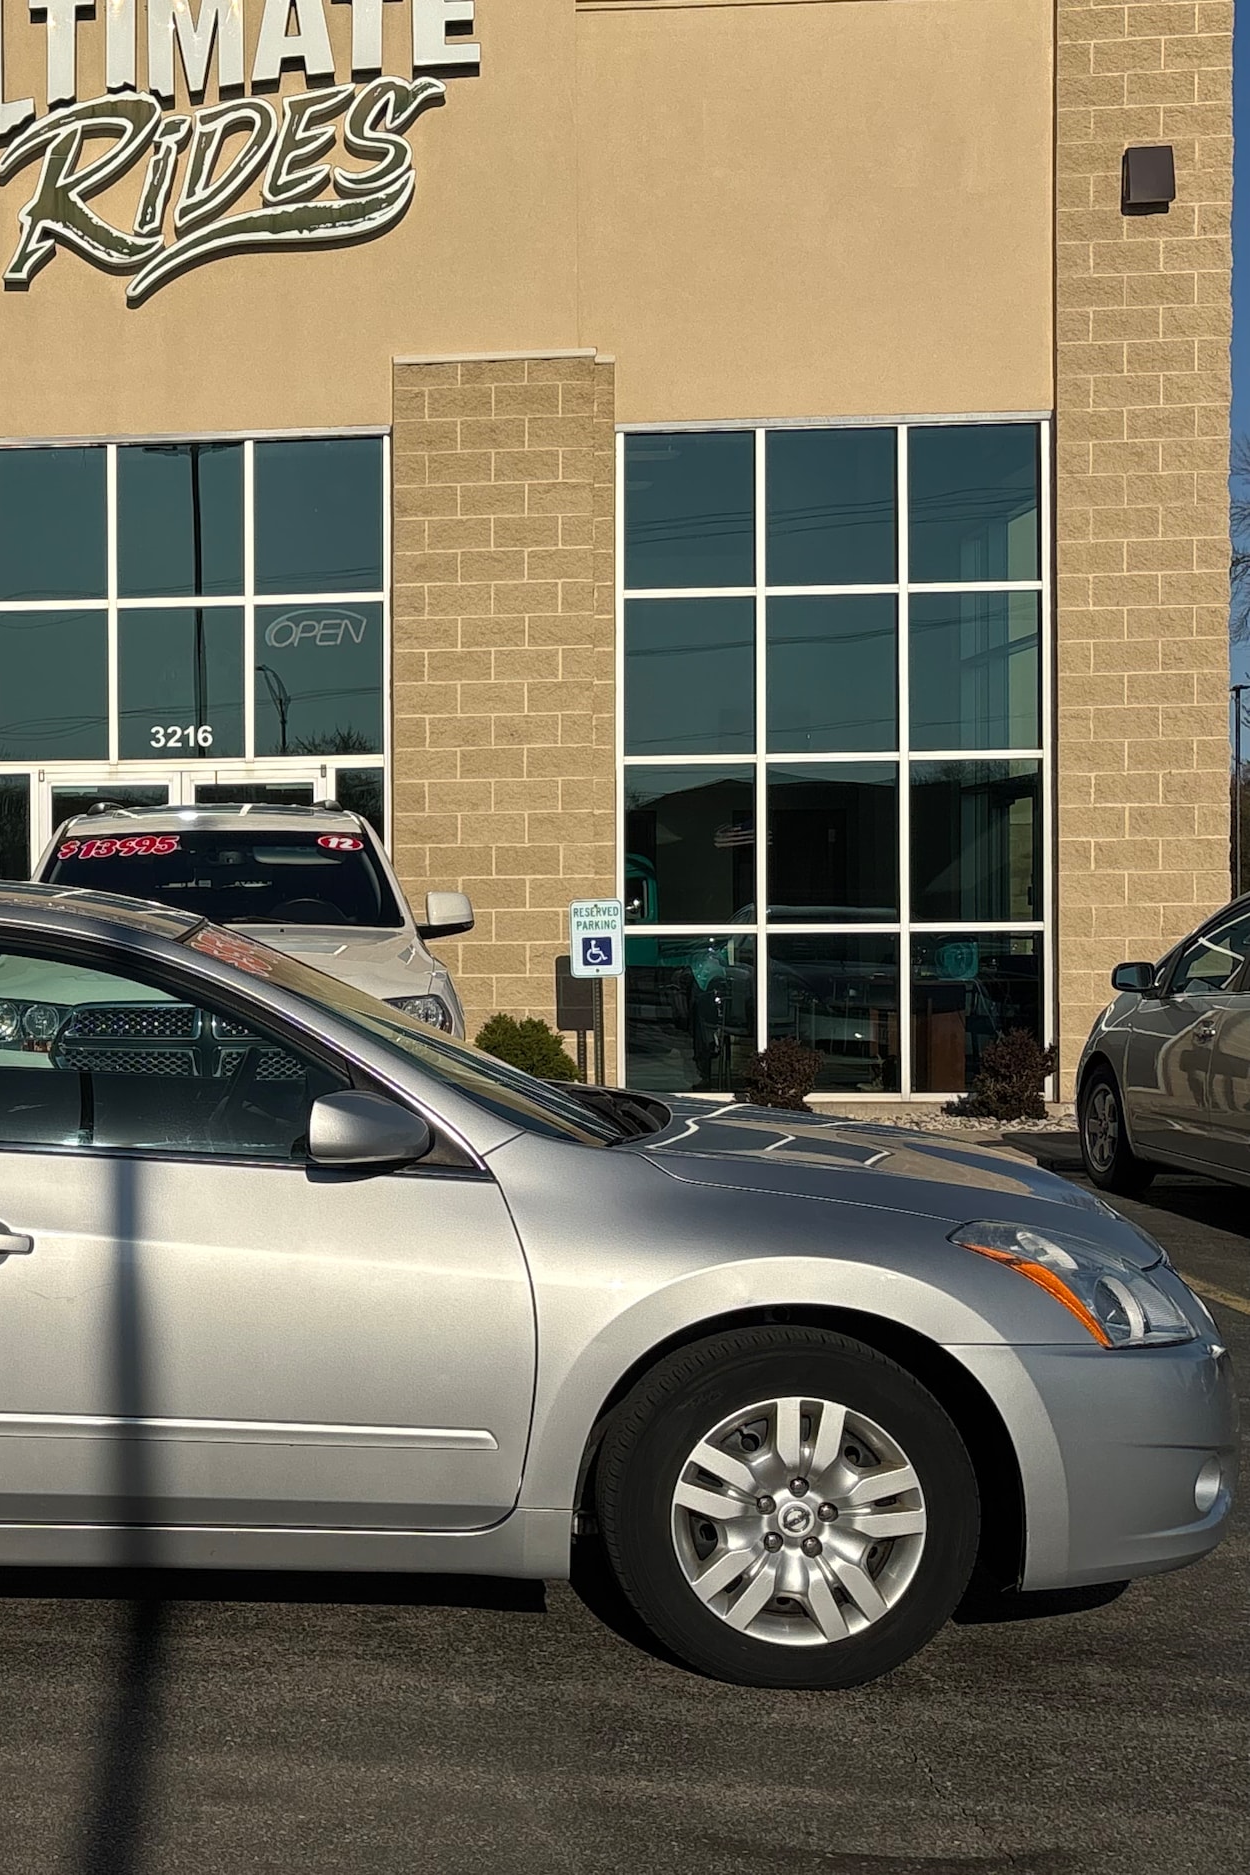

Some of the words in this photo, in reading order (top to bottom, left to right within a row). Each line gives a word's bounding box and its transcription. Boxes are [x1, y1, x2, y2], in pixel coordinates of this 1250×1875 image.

[270, 618, 368, 648] OPEN
[149, 724, 214, 748] 3216
[572, 905, 620, 918] RESERVED
[575, 919, 618, 931] PARKING
